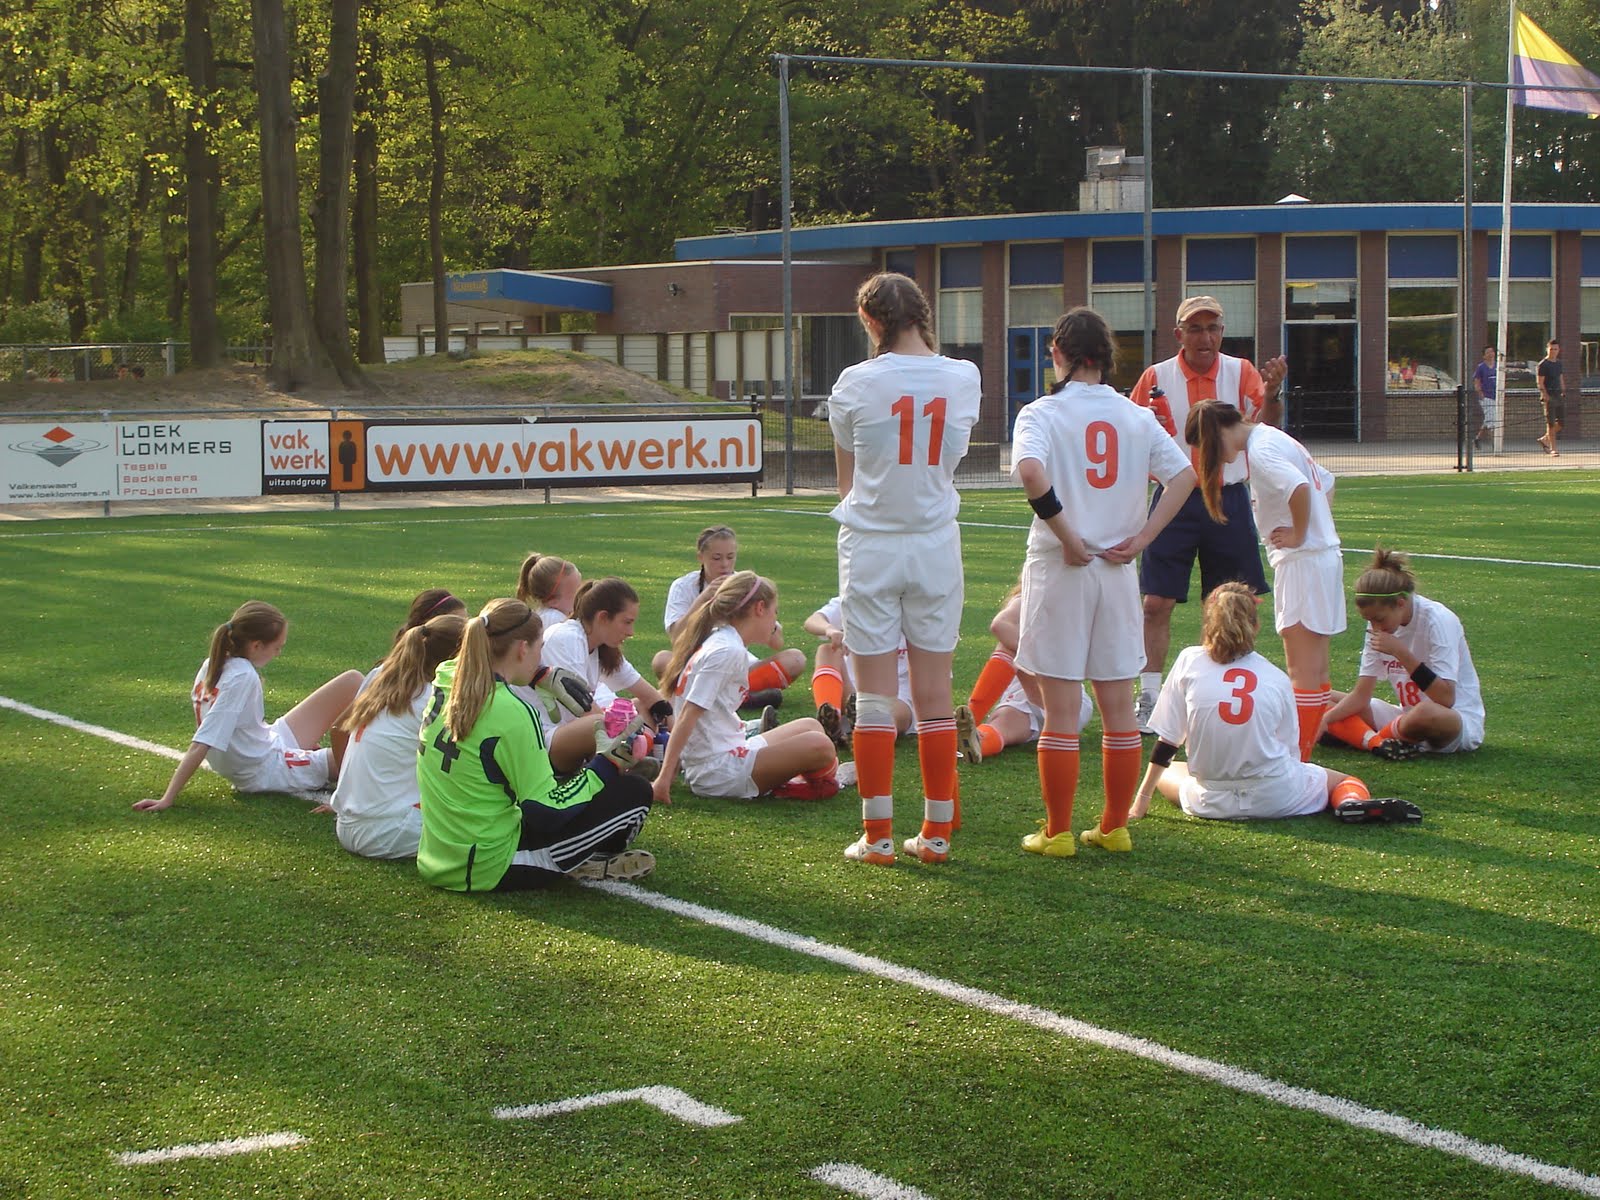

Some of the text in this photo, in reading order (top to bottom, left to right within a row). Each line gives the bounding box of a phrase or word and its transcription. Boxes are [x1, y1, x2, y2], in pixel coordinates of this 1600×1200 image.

[122, 425, 182, 439] LOEK
[269, 428, 310, 450] vak
[891, 395, 947, 466] 11
[122, 441, 232, 456] LOMMERS
[374, 424, 755, 476] www.vakwerk.nl
[1085, 421, 1119, 489] 9
[123, 463, 168, 471] Tegels
[270, 449, 326, 471] werk
[9, 482, 78, 490] Valkenswaard
[123, 474, 198, 483] Badkamers
[269, 478, 327, 488] uitzendgroep
[123, 486, 198, 496] Projecten
[1218, 668, 1258, 725] 3
[1396, 681, 1421, 707] 18
